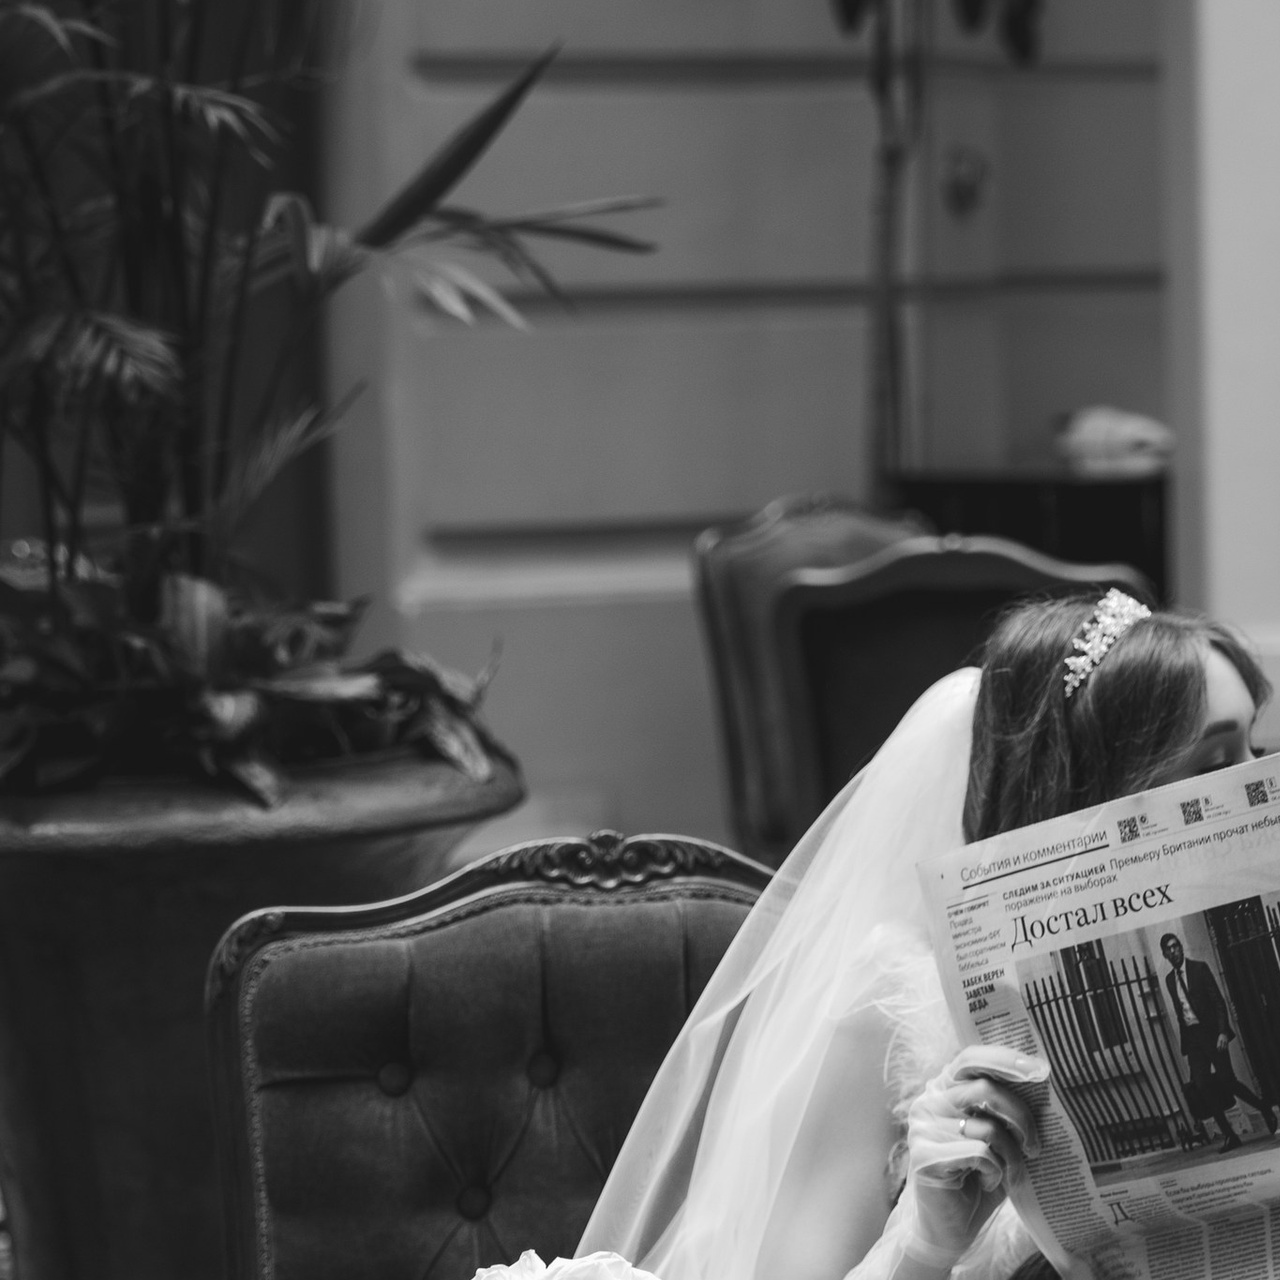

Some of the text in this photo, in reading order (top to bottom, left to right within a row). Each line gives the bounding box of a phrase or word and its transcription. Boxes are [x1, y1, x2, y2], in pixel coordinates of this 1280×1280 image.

[960, 830, 1107, 882] События и комментарии
[1002, 883, 1038, 900] СЛЕДИМ
[1040, 879, 1051, 890] ЗА
[1052, 864, 1106, 887] СИТУАЦИЕЙ
[1109, 845, 1161, 871] Премьеру
[1161, 833, 1212, 857] Британии
[1212, 825, 1250, 845] прочат
[1005, 874, 1118, 913] поражение на выборах
[1011, 883, 1175, 952] Достал всех
[962, 968, 1005, 988] ХАБЕК ВЕРЕН
[965, 983, 996, 1000] ЗАВЕТАМ
